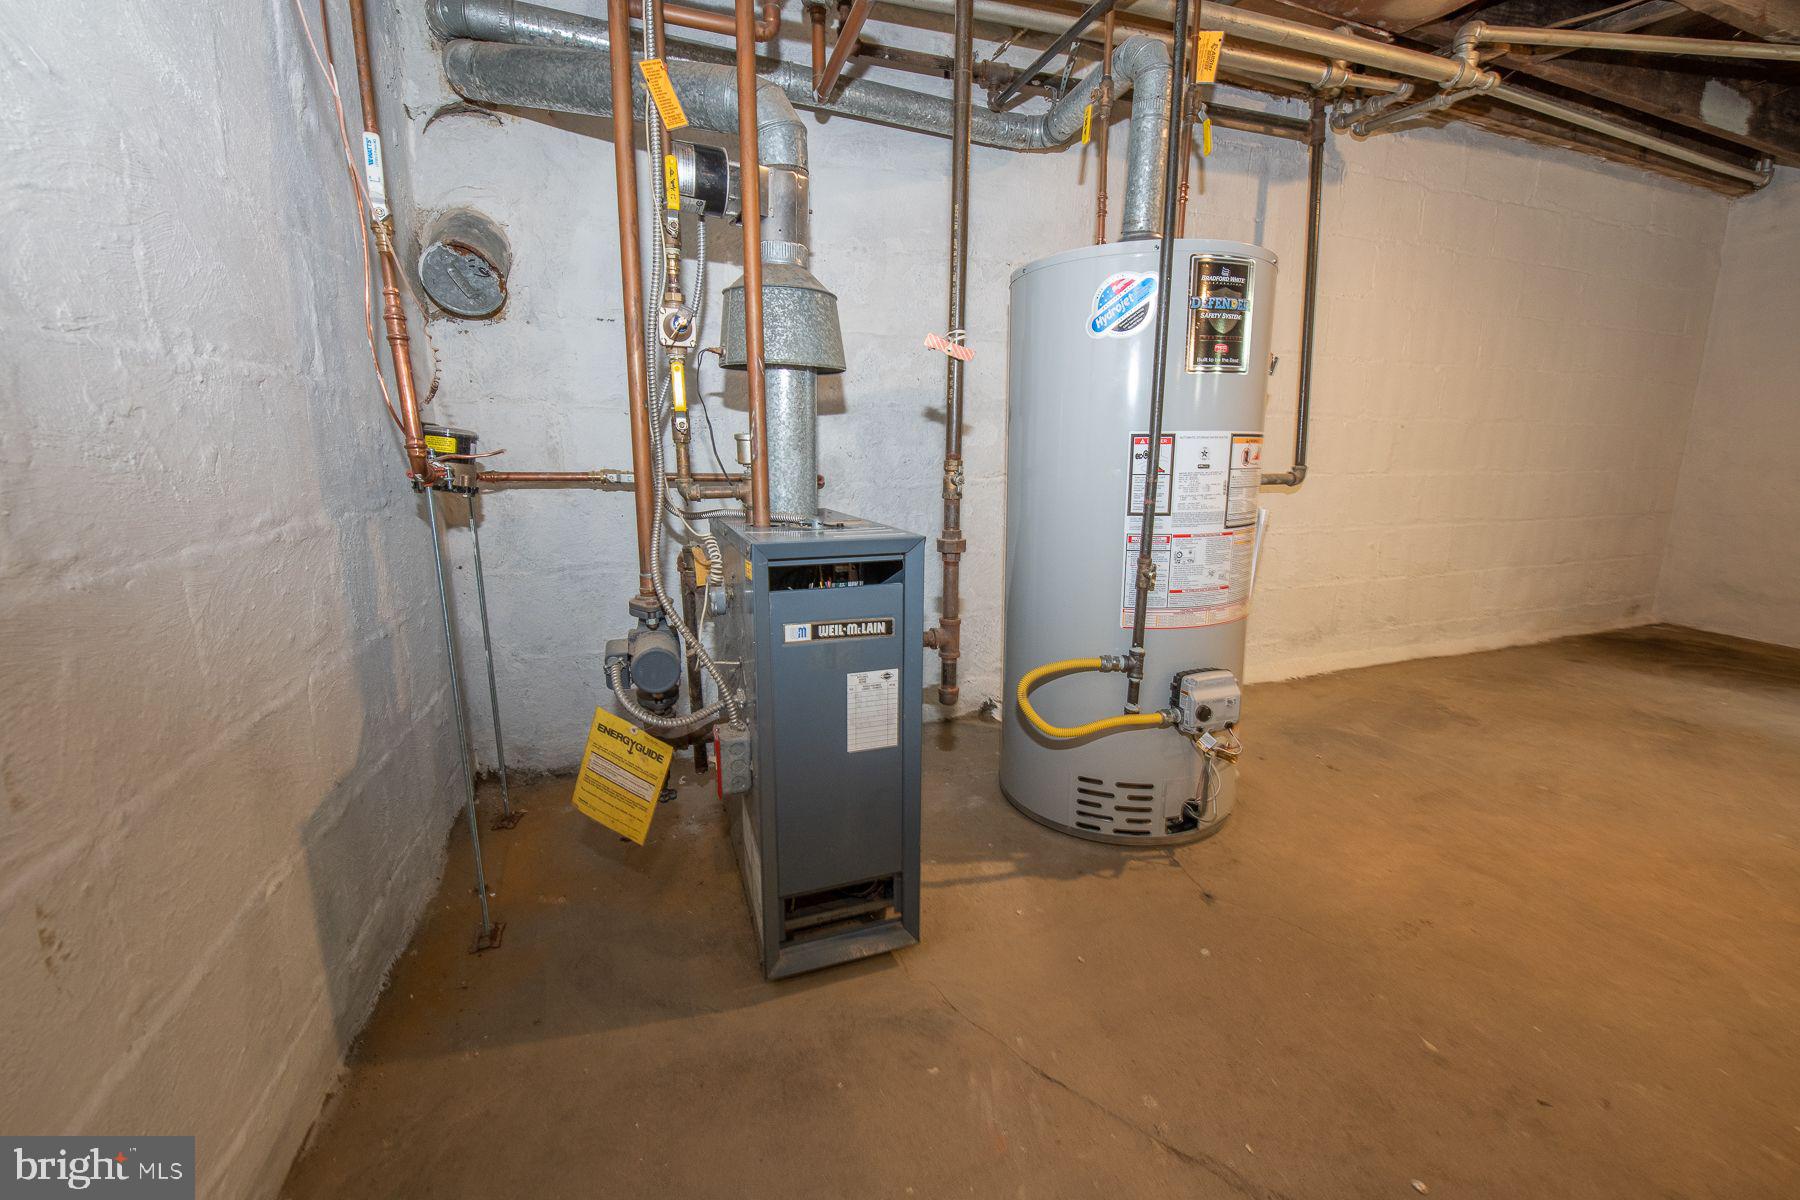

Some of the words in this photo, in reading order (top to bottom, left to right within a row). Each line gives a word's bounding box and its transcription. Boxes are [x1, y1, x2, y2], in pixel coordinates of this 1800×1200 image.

[1095, 293, 1135, 329] Hydrojet
[1191, 297, 1249, 311] DEFENDER
[597, 723, 665, 764] ENERGYGUIDE
